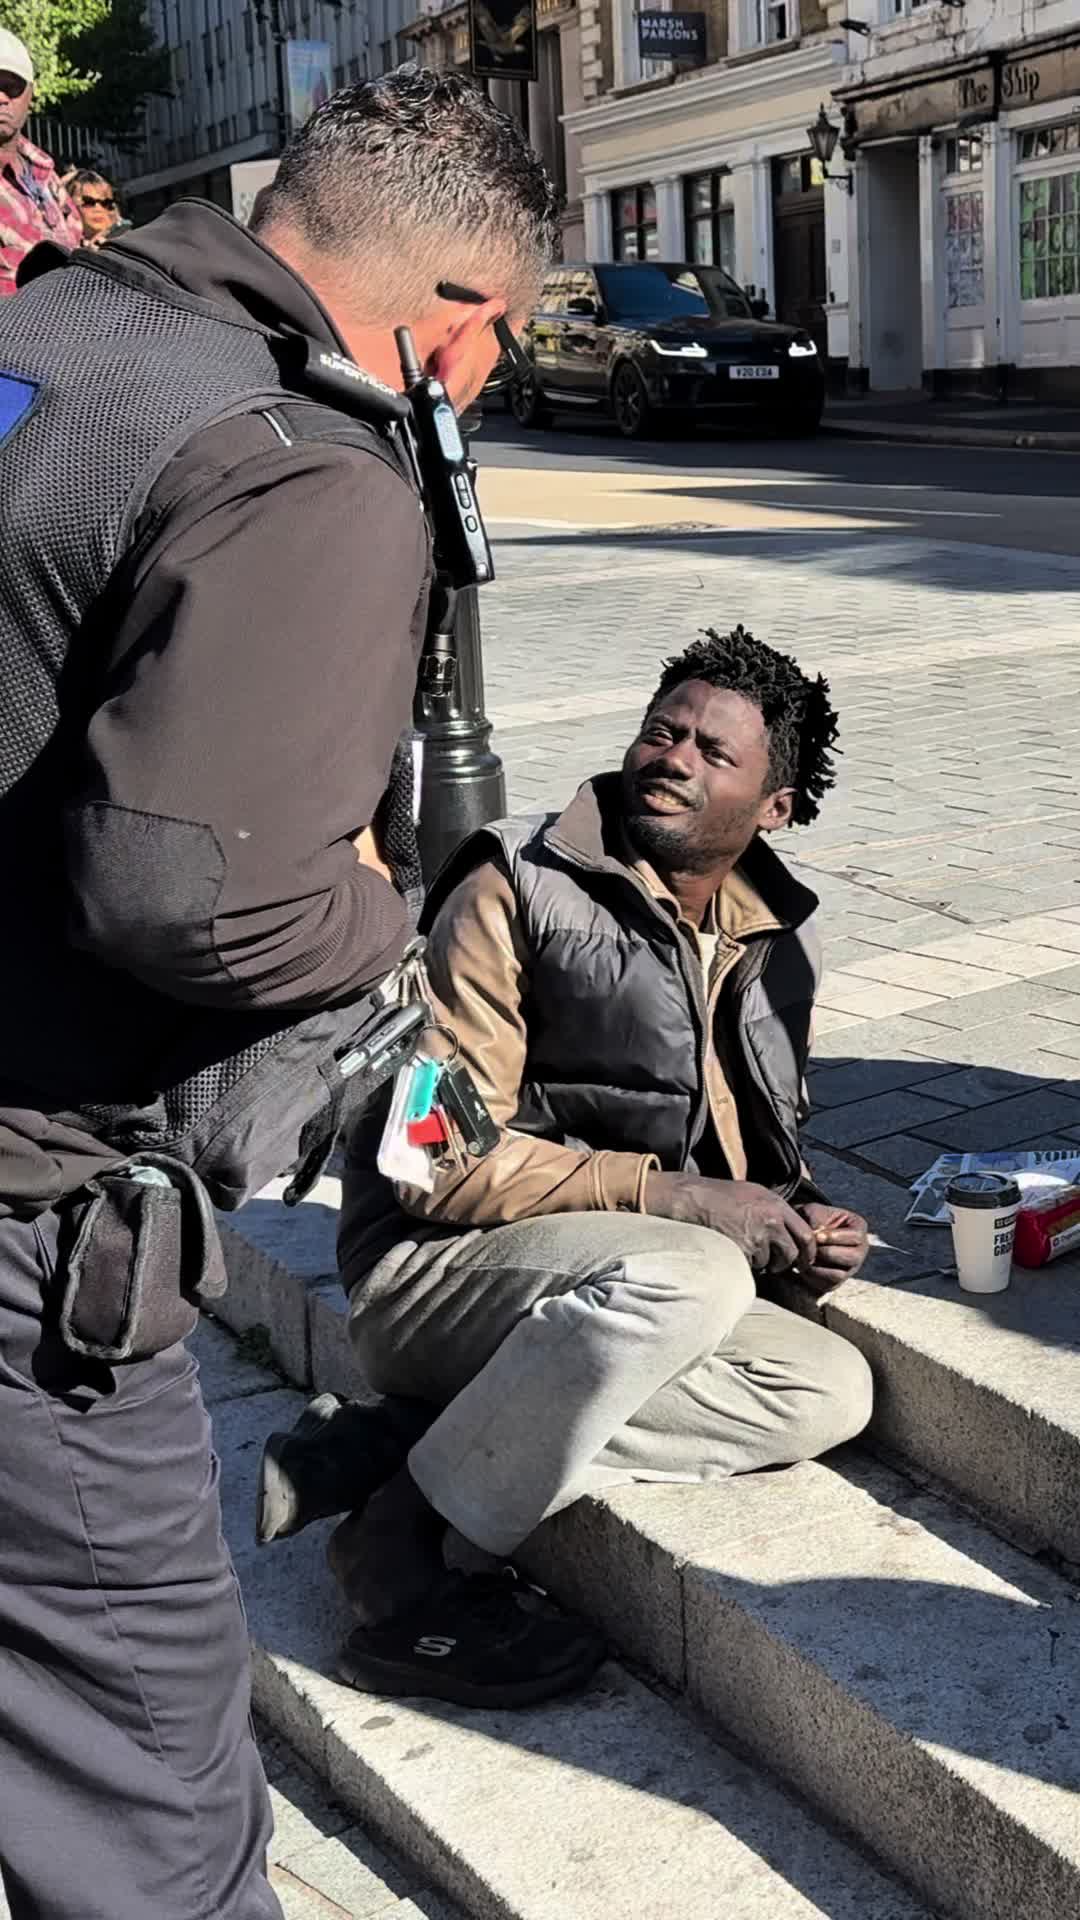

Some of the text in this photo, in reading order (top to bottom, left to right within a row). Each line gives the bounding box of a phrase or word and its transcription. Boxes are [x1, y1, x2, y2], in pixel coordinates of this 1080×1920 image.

[641, 18, 683, 29] MARSH
[642, 28, 698, 40] PARSONS
[958, 65, 1040, 108] The Ship
[320, 354, 397, 398] SUPERVISOR
